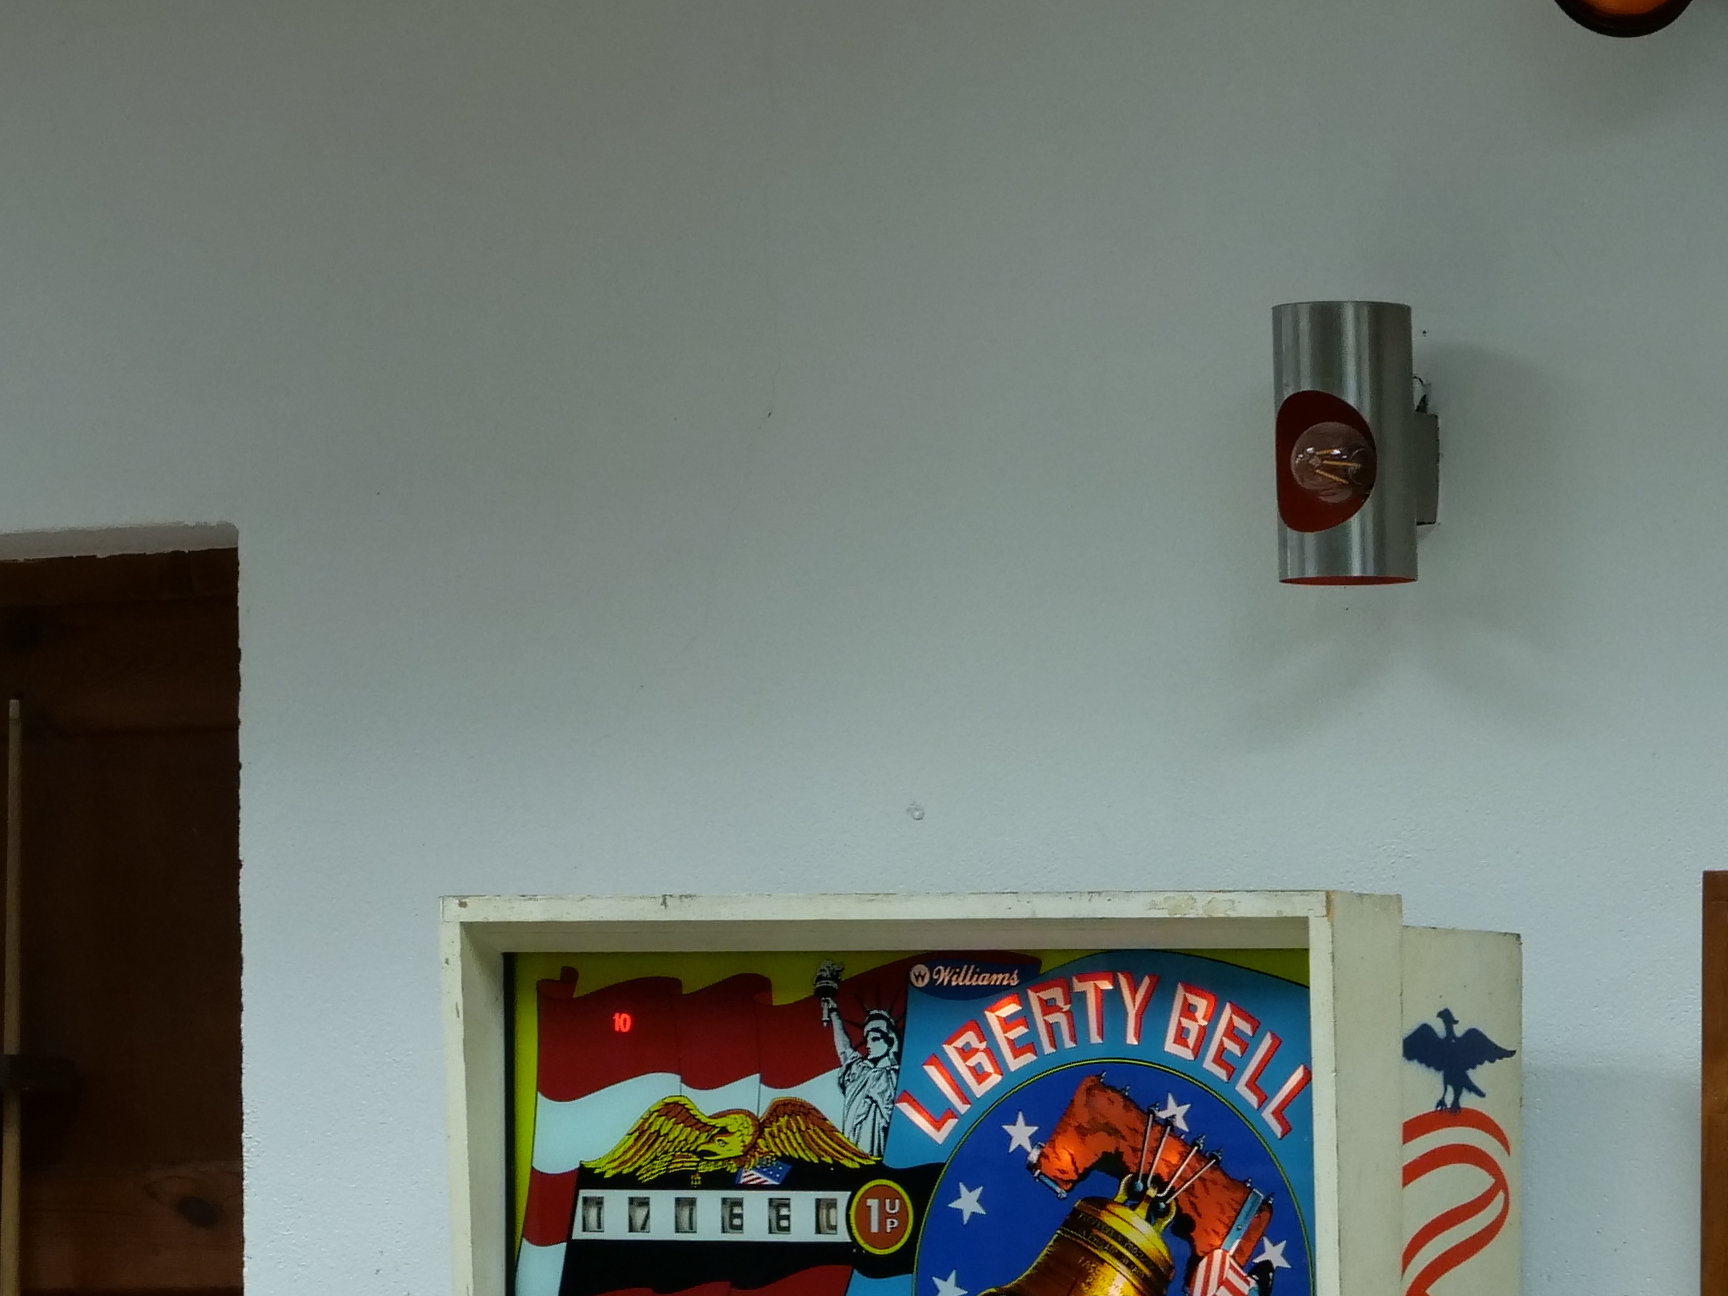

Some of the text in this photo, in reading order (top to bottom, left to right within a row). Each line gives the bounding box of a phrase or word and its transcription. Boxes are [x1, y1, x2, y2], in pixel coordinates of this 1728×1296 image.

[932, 966, 1020, 987] Williams
[611, 1012, 632, 1031] 10
[896, 971, 1312, 1145] LIBERTY BELL
[865, 1198, 879, 1232] 1
